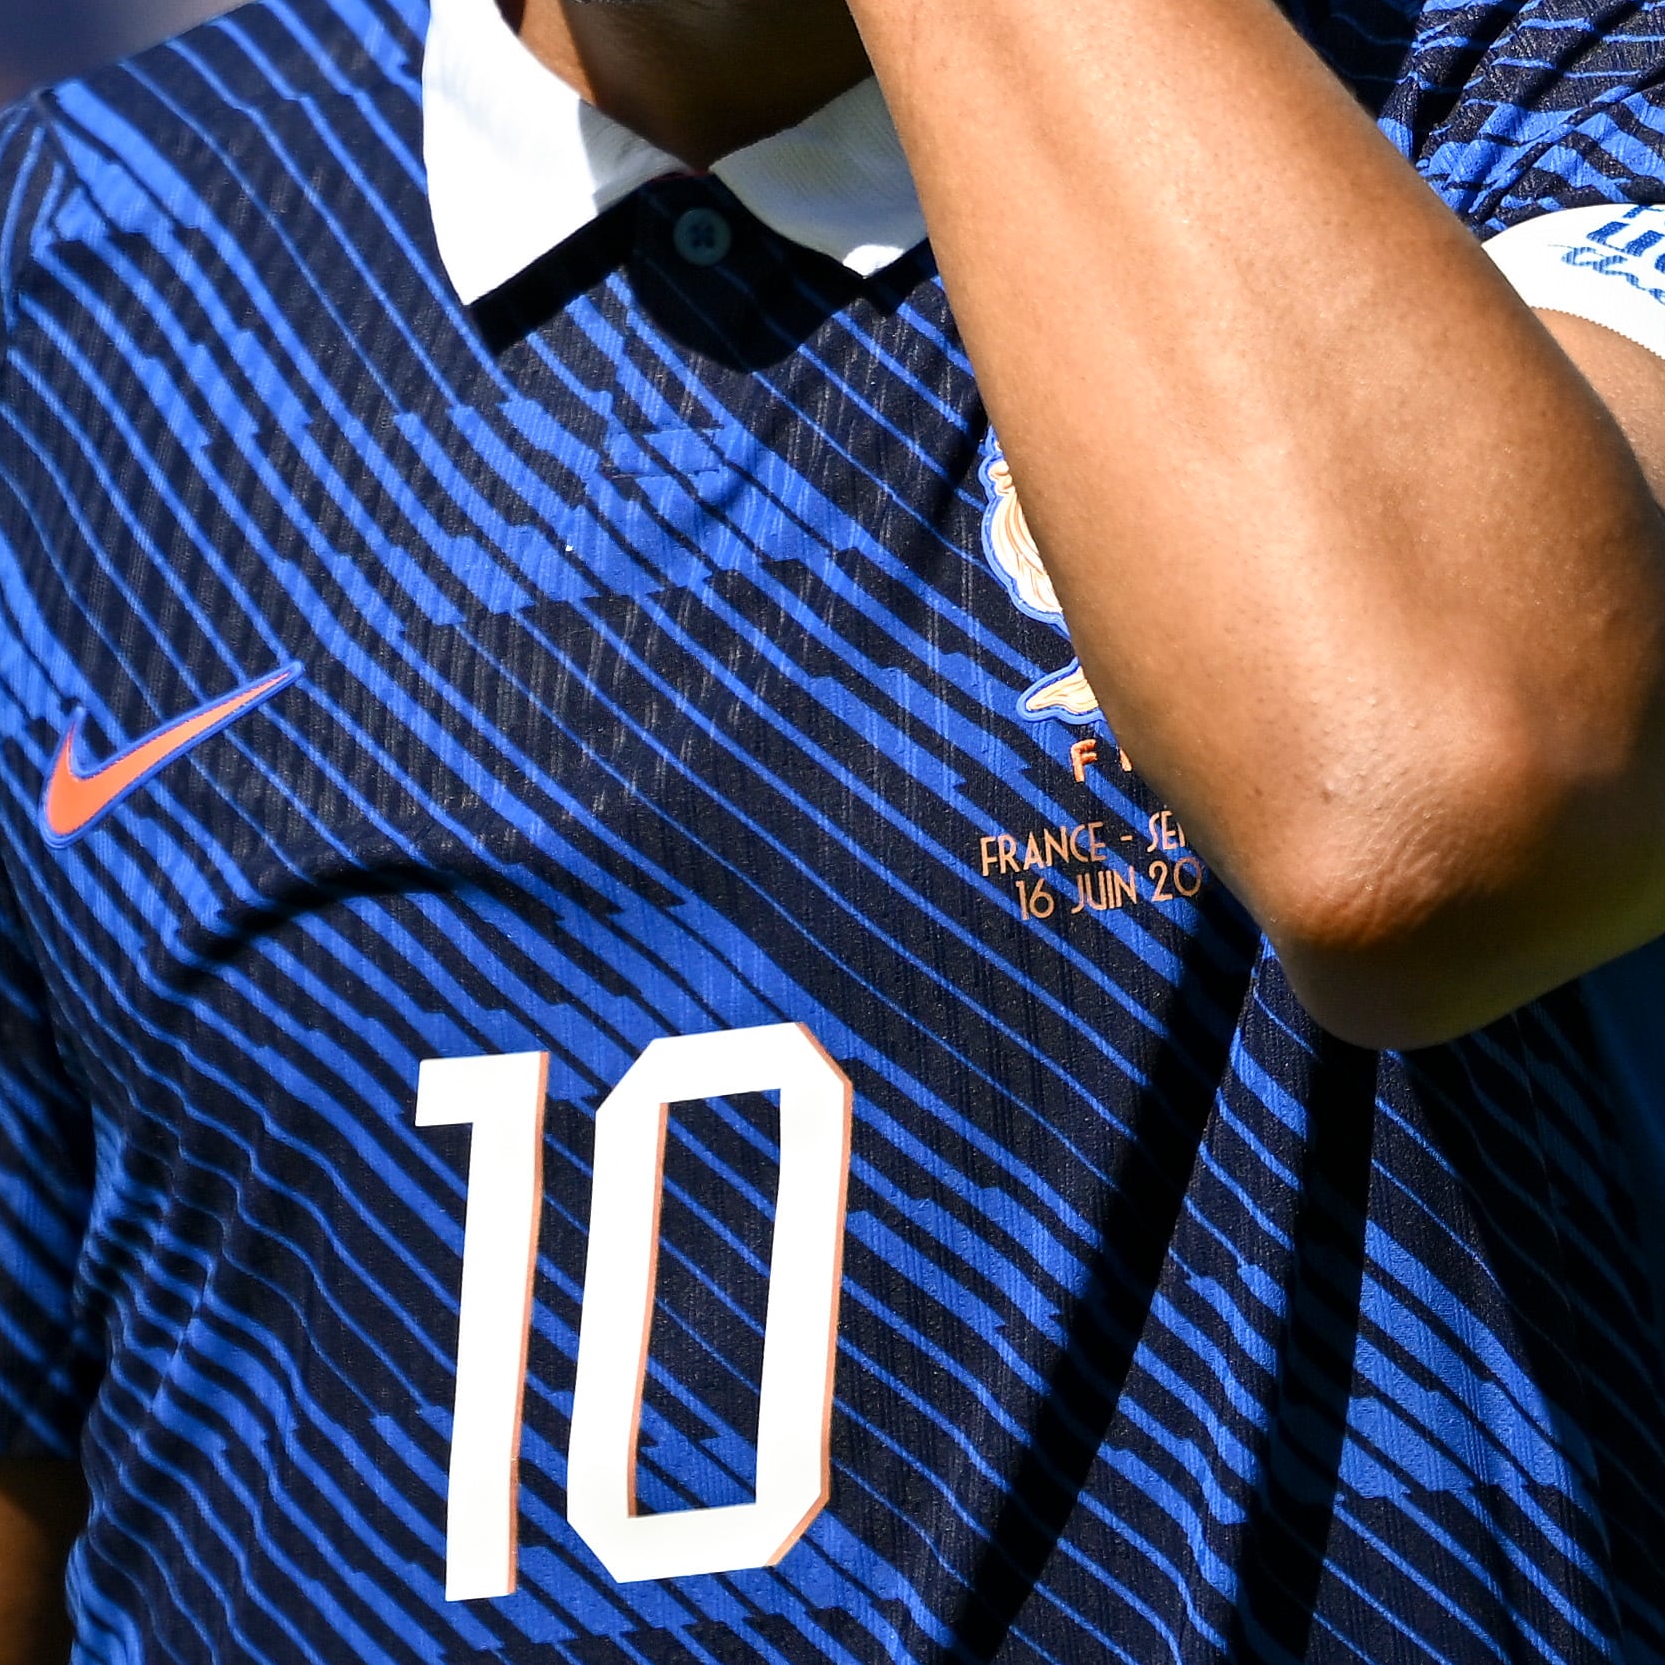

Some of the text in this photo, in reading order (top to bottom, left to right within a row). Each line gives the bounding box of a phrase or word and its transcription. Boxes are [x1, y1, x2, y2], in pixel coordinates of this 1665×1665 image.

[980, 821, 1106, 877] FRANCE
[1015, 878, 1055, 921] 16
[1071, 865, 1138, 915] JUIN
[415, 1022, 853, 1602] 10
